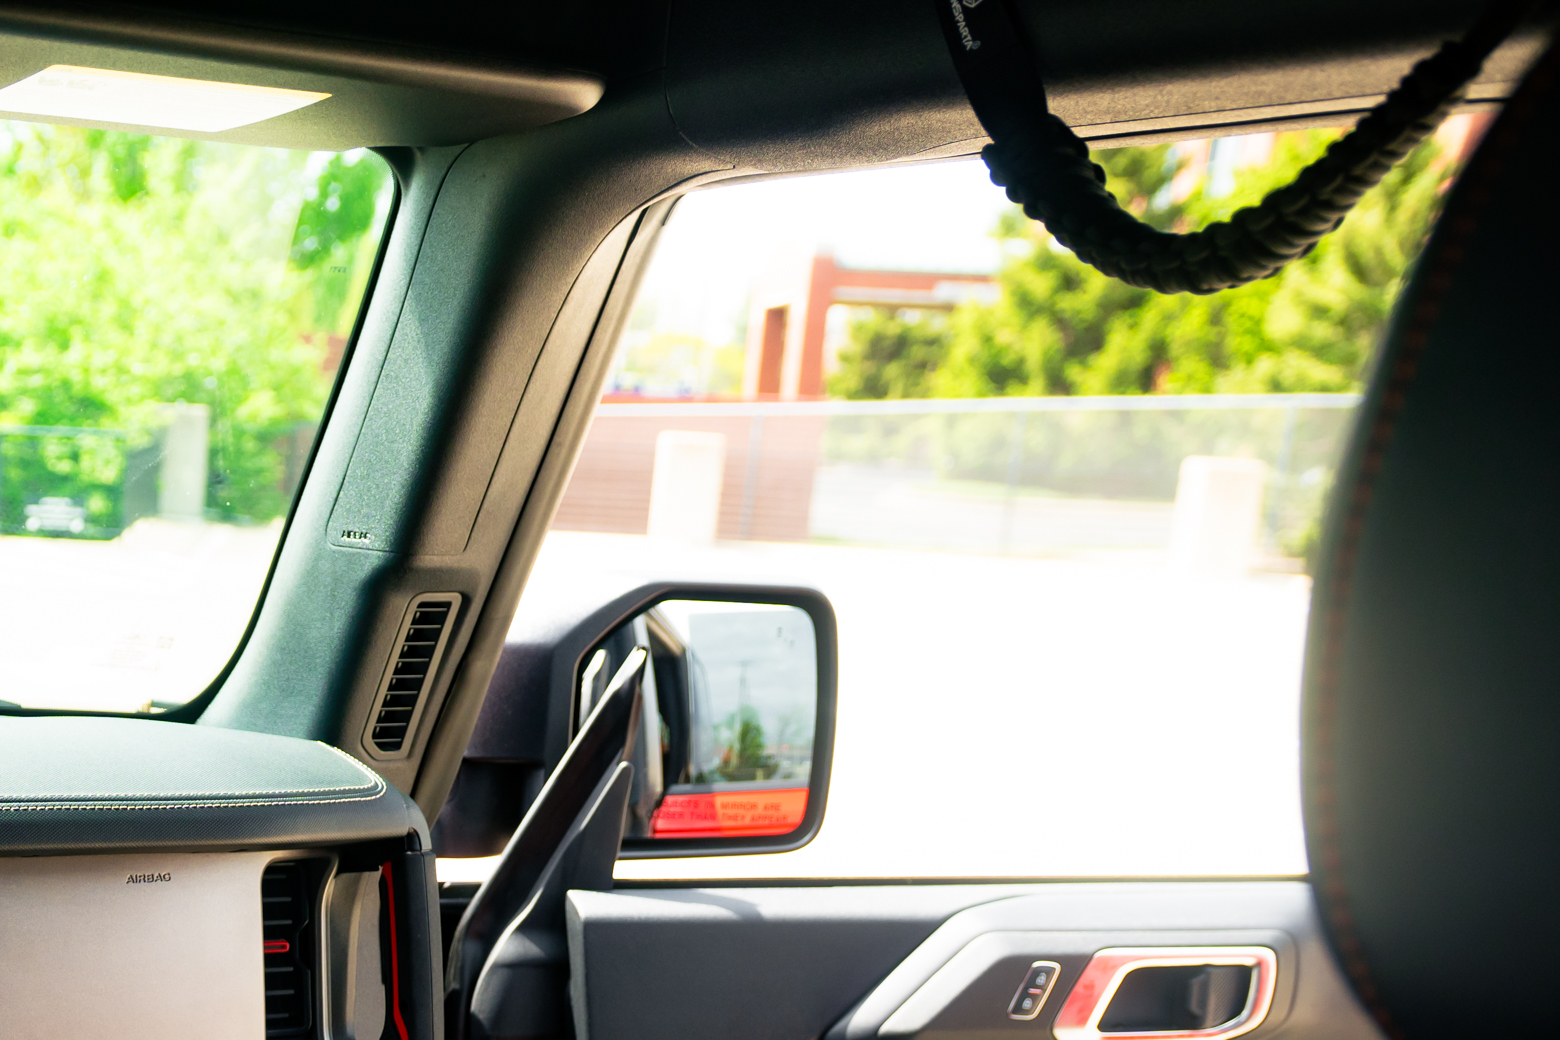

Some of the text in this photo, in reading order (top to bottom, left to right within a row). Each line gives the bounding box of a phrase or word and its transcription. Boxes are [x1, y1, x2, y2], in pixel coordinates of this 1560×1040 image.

[659, 799, 699, 809] BJECTS
[720, 801, 759, 811] MIRROR
[126, 872, 172, 884] AIRBAG
